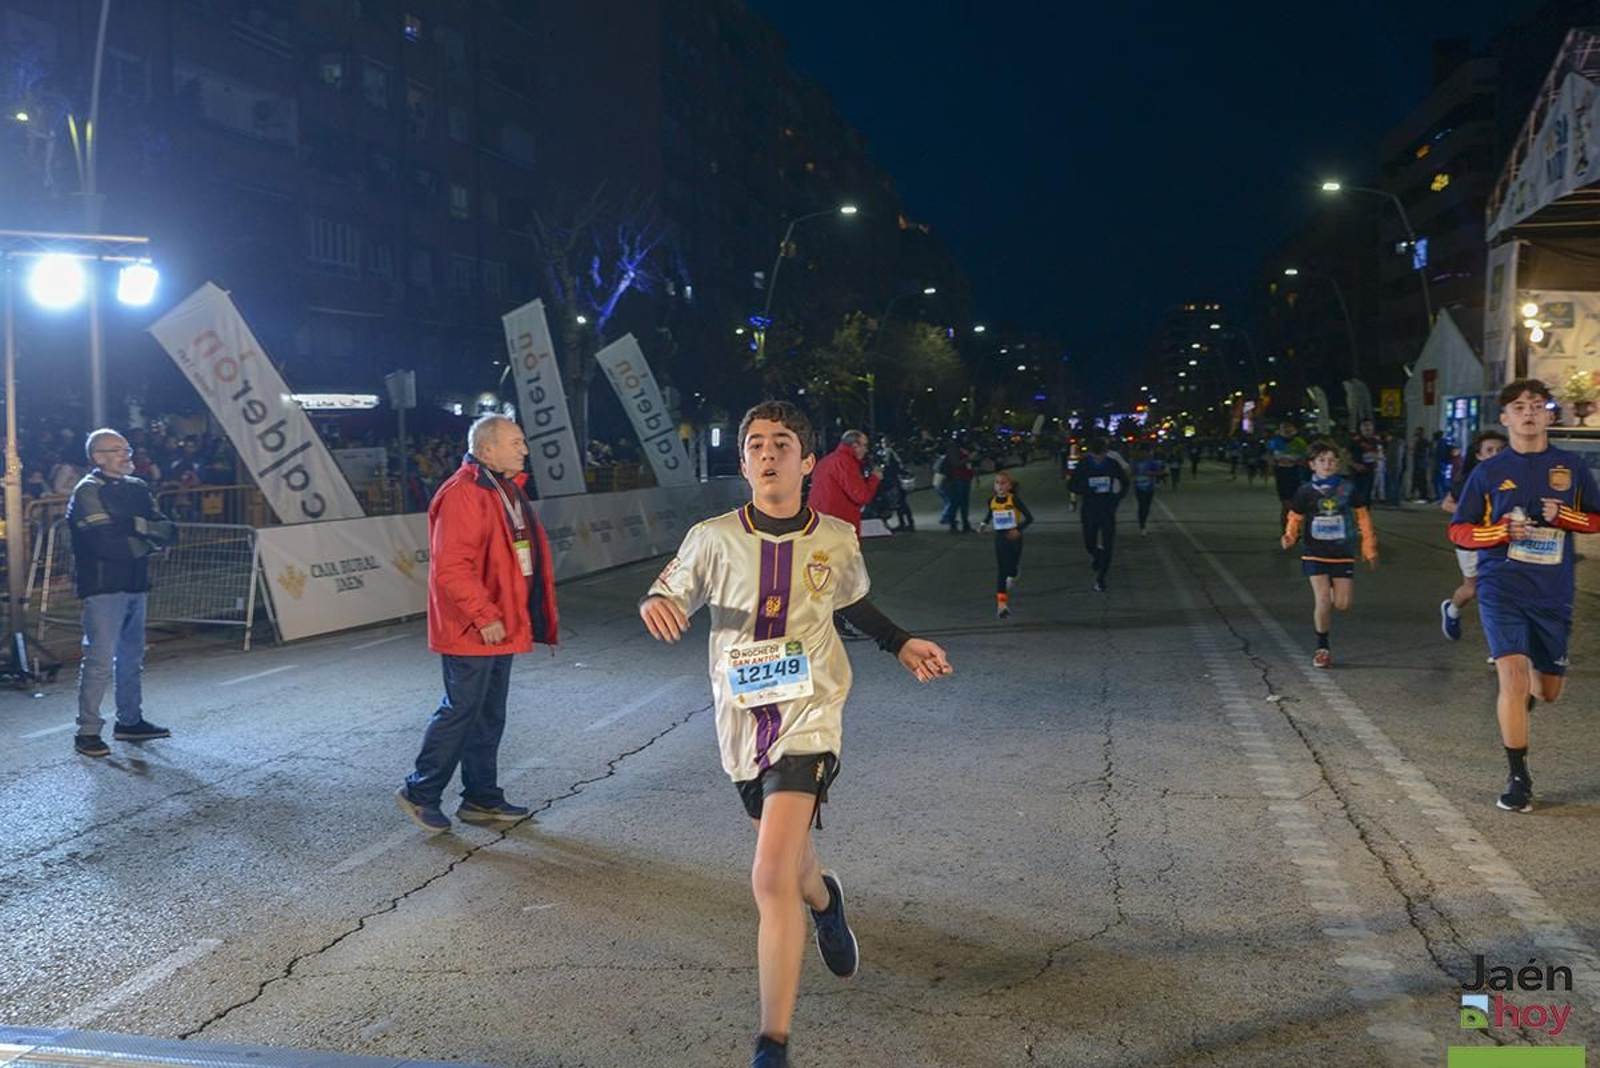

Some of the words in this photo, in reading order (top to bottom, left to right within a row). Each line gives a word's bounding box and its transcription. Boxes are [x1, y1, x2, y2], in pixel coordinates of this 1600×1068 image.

[741, 646, 768, 658] NOCHE
[732, 659, 750, 667] SAN
[737, 658, 800, 685] 12149
